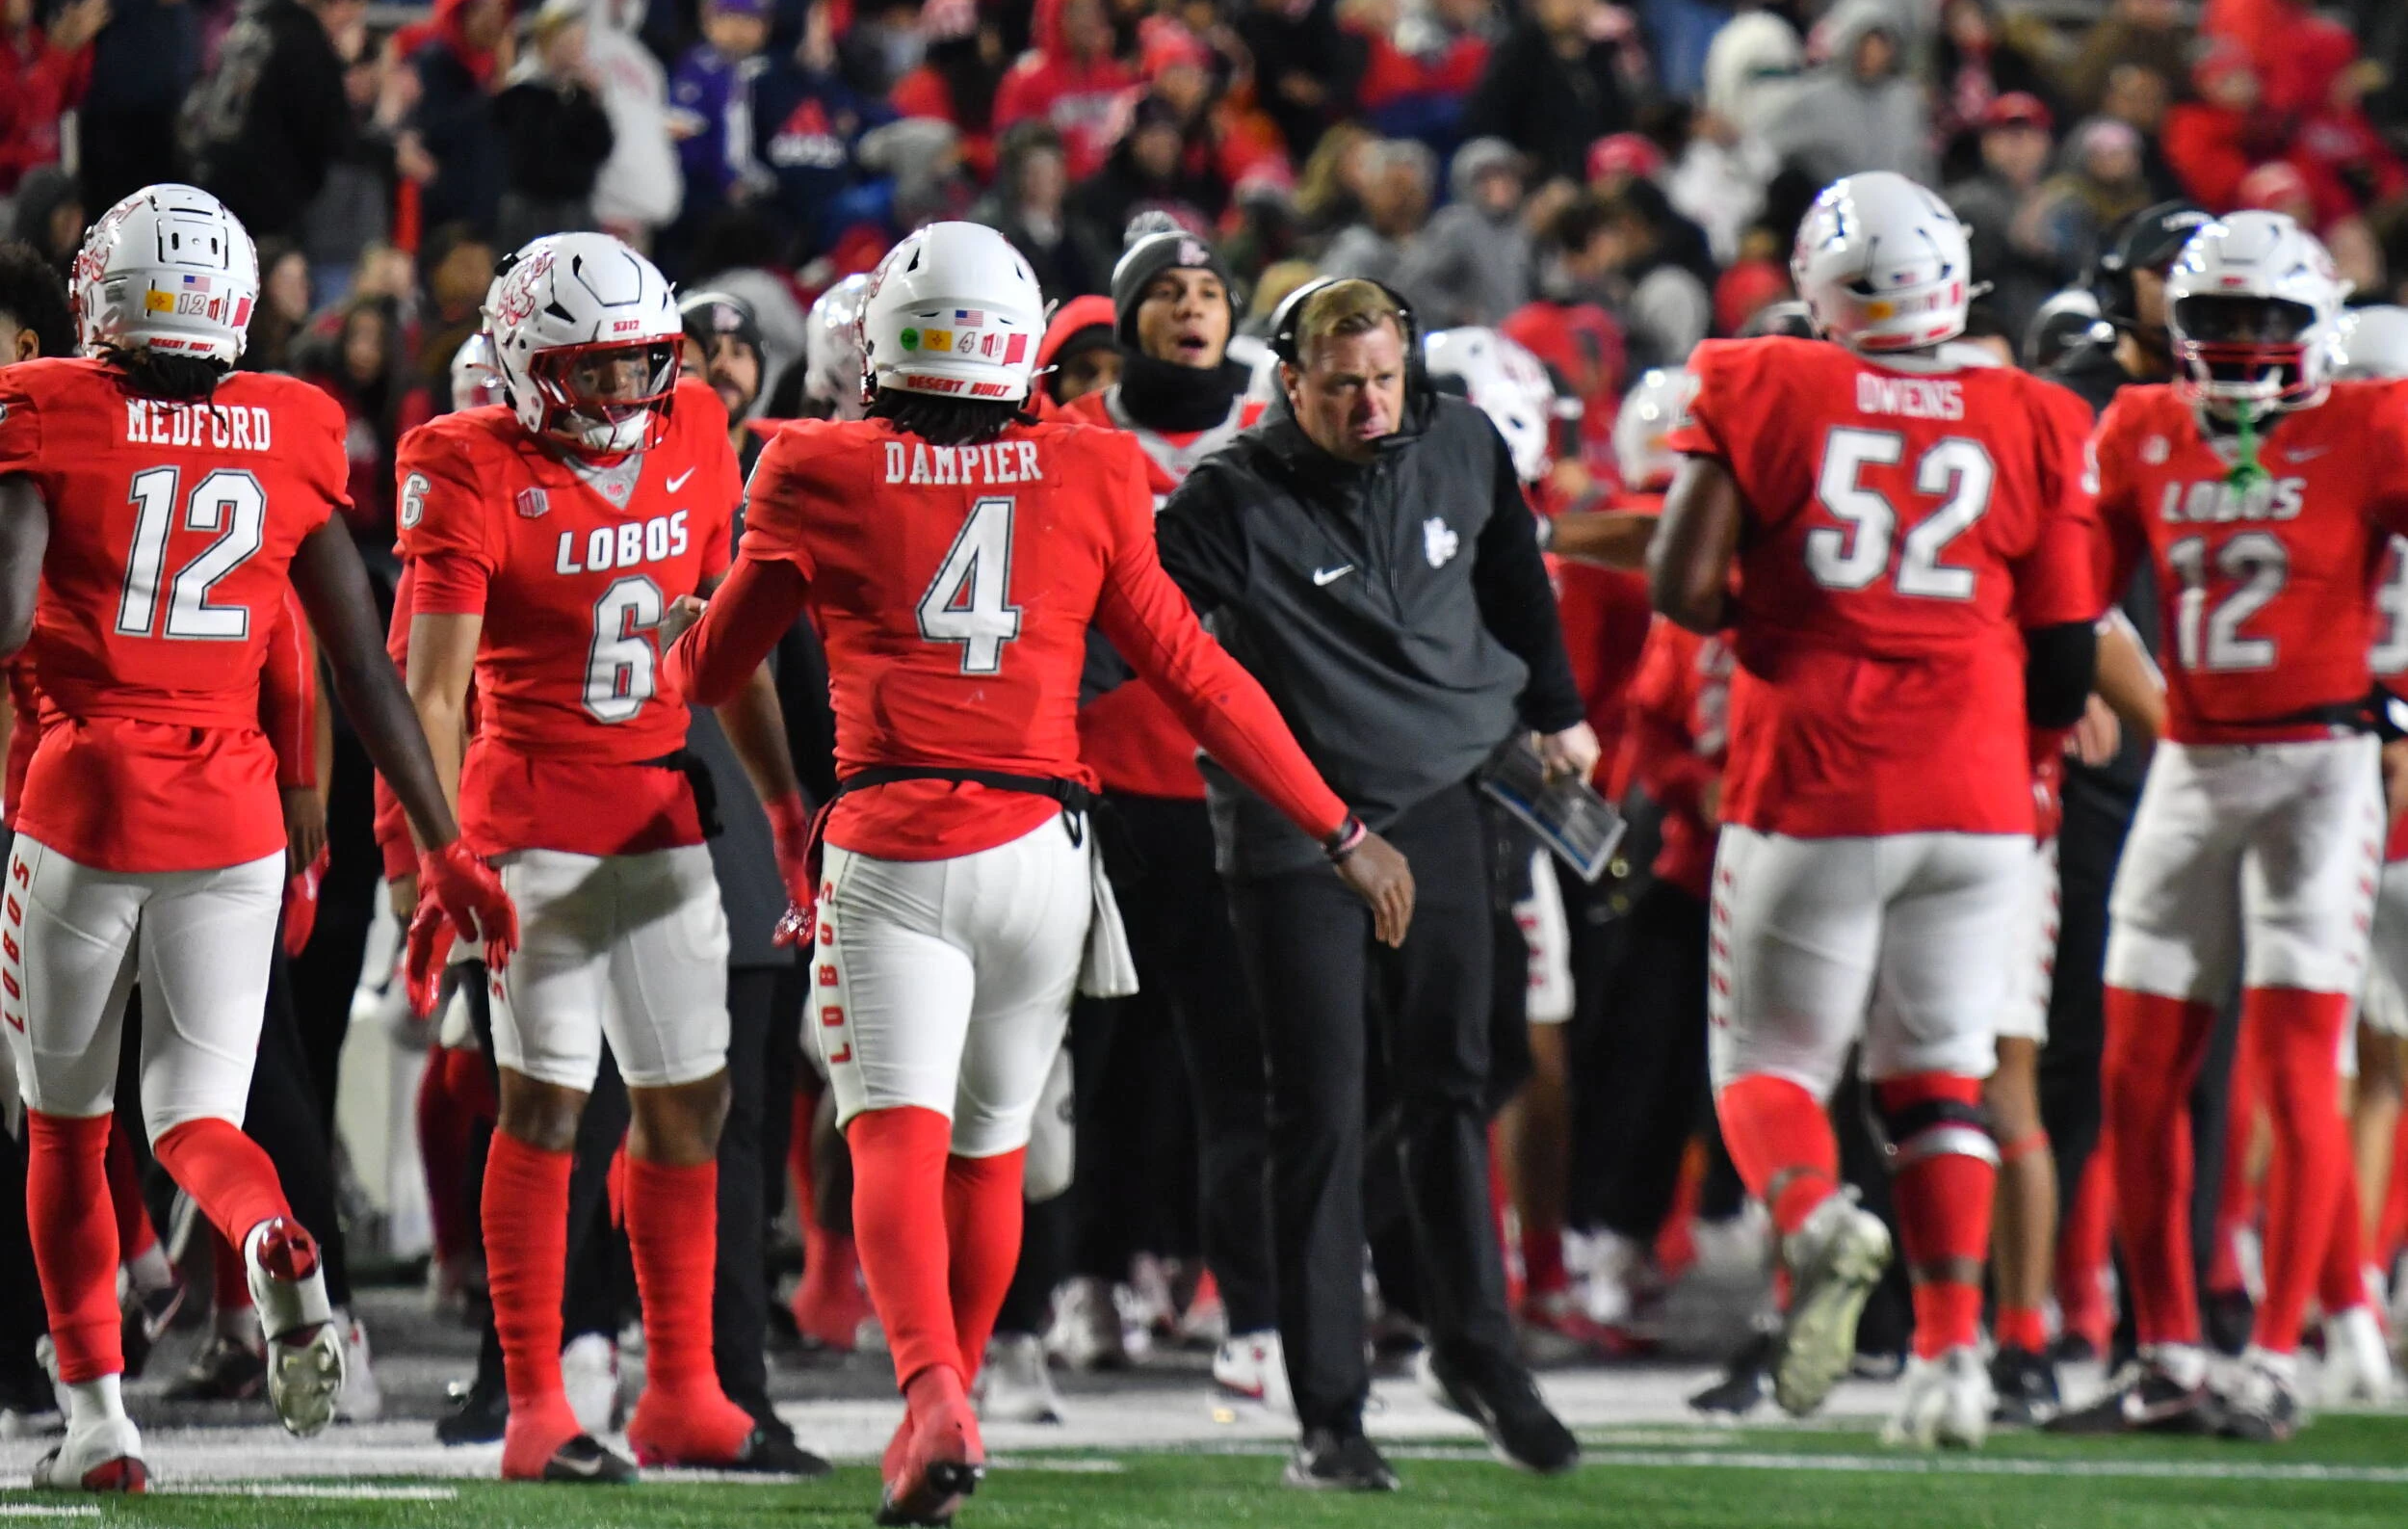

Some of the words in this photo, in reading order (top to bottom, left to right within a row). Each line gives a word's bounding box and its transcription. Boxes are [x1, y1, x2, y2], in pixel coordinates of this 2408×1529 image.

[177, 293, 208, 315] 12
[957, 330, 976, 354] 4
[907, 375, 966, 393] DESERT
[969, 382, 1011, 397] BUILT
[1855, 372, 1965, 421] OWENS
[126, 399, 272, 451] MEDFORD
[884, 440, 1043, 485] DAMPIER
[400, 470, 431, 529] 6
[1803, 425, 1998, 602] 52
[2159, 477, 2309, 523] LOBOS
[115, 464, 267, 641] 12
[555, 509, 689, 575] LOBOS
[915, 495, 1024, 675] 4
[2167, 531, 2289, 672] 12
[582, 573, 664, 723] 6
[2, 854, 29, 1035] LOBOS
[820, 881, 851, 1064] LOBOS
